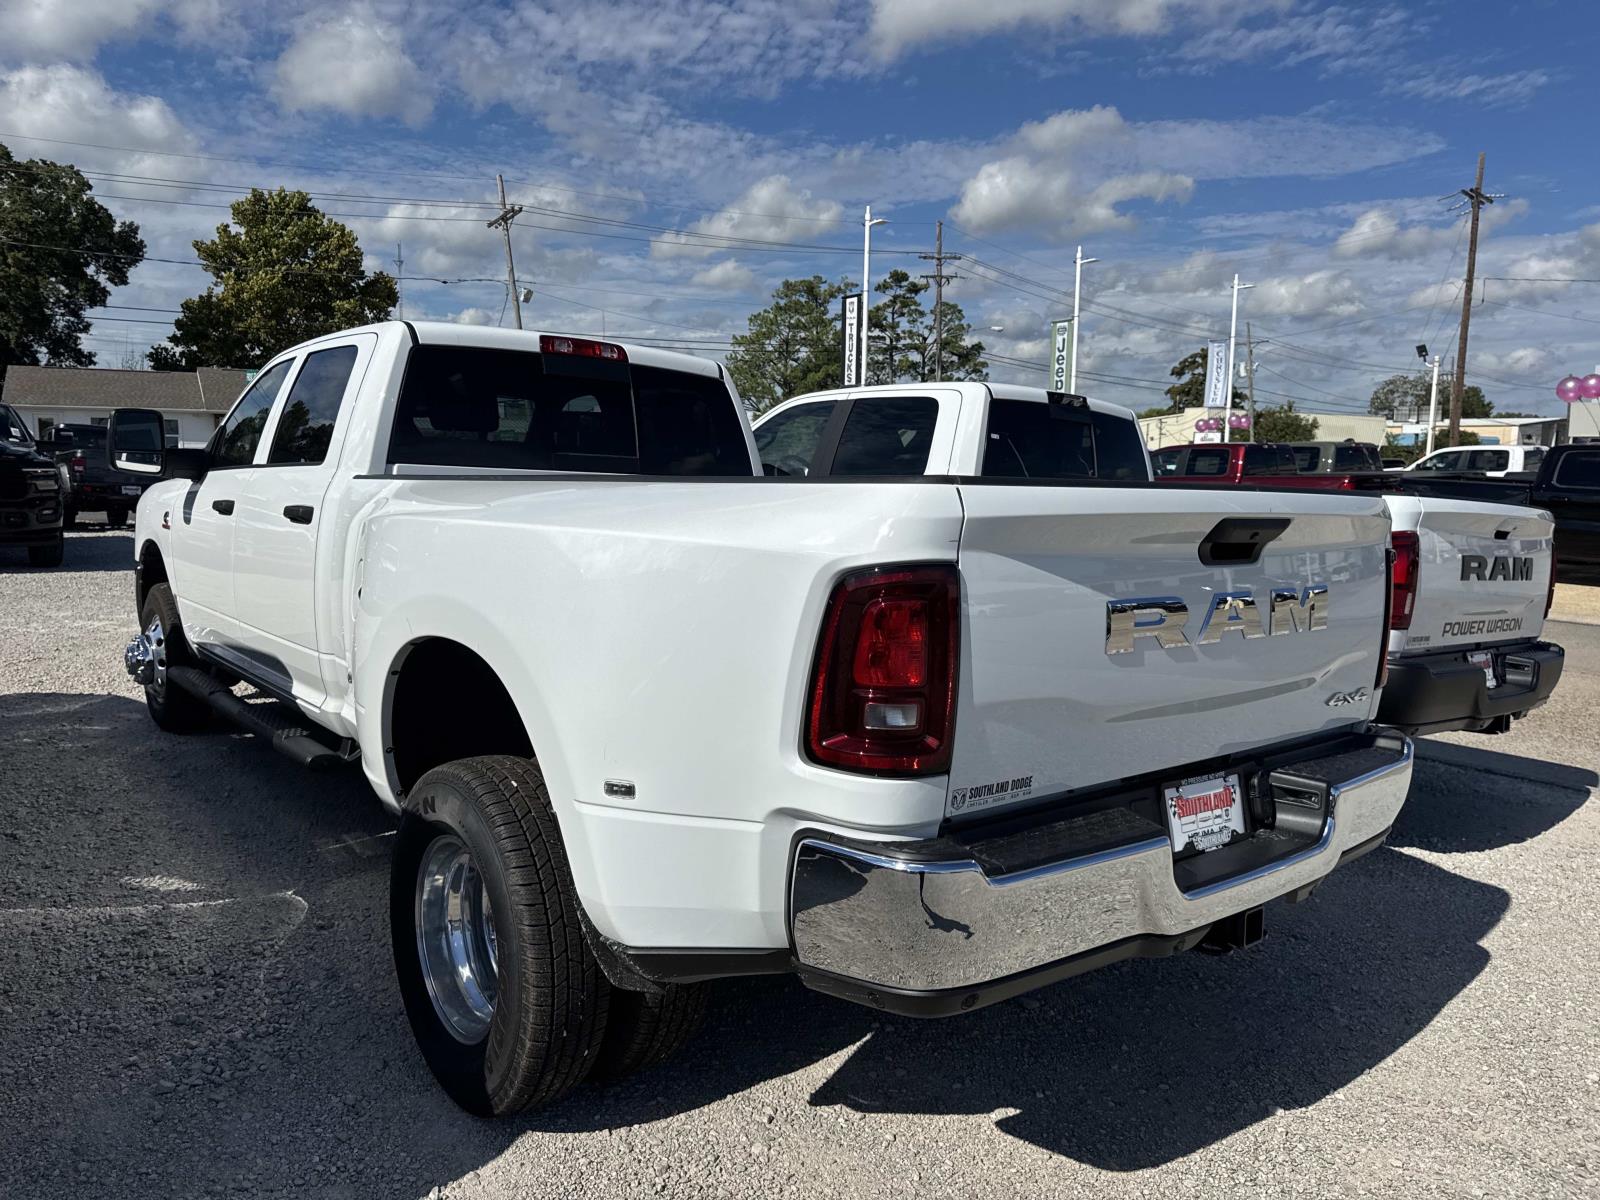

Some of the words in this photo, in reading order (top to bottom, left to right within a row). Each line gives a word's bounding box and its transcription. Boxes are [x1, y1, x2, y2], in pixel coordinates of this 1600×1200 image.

[847, 323, 855, 384] TRUCKS
[1055, 338, 1066, 391] Jeep
[1460, 555, 1533, 581] RAM
[1105, 584, 1328, 655] RAM
[1442, 620, 1486, 637] POWER
[1486, 617, 1523, 633] WAGON
[969, 781, 1009, 799] SOUTHLAND
[1010, 776, 1033, 791] DODGE
[1176, 786, 1232, 819] SOUTHLAND
